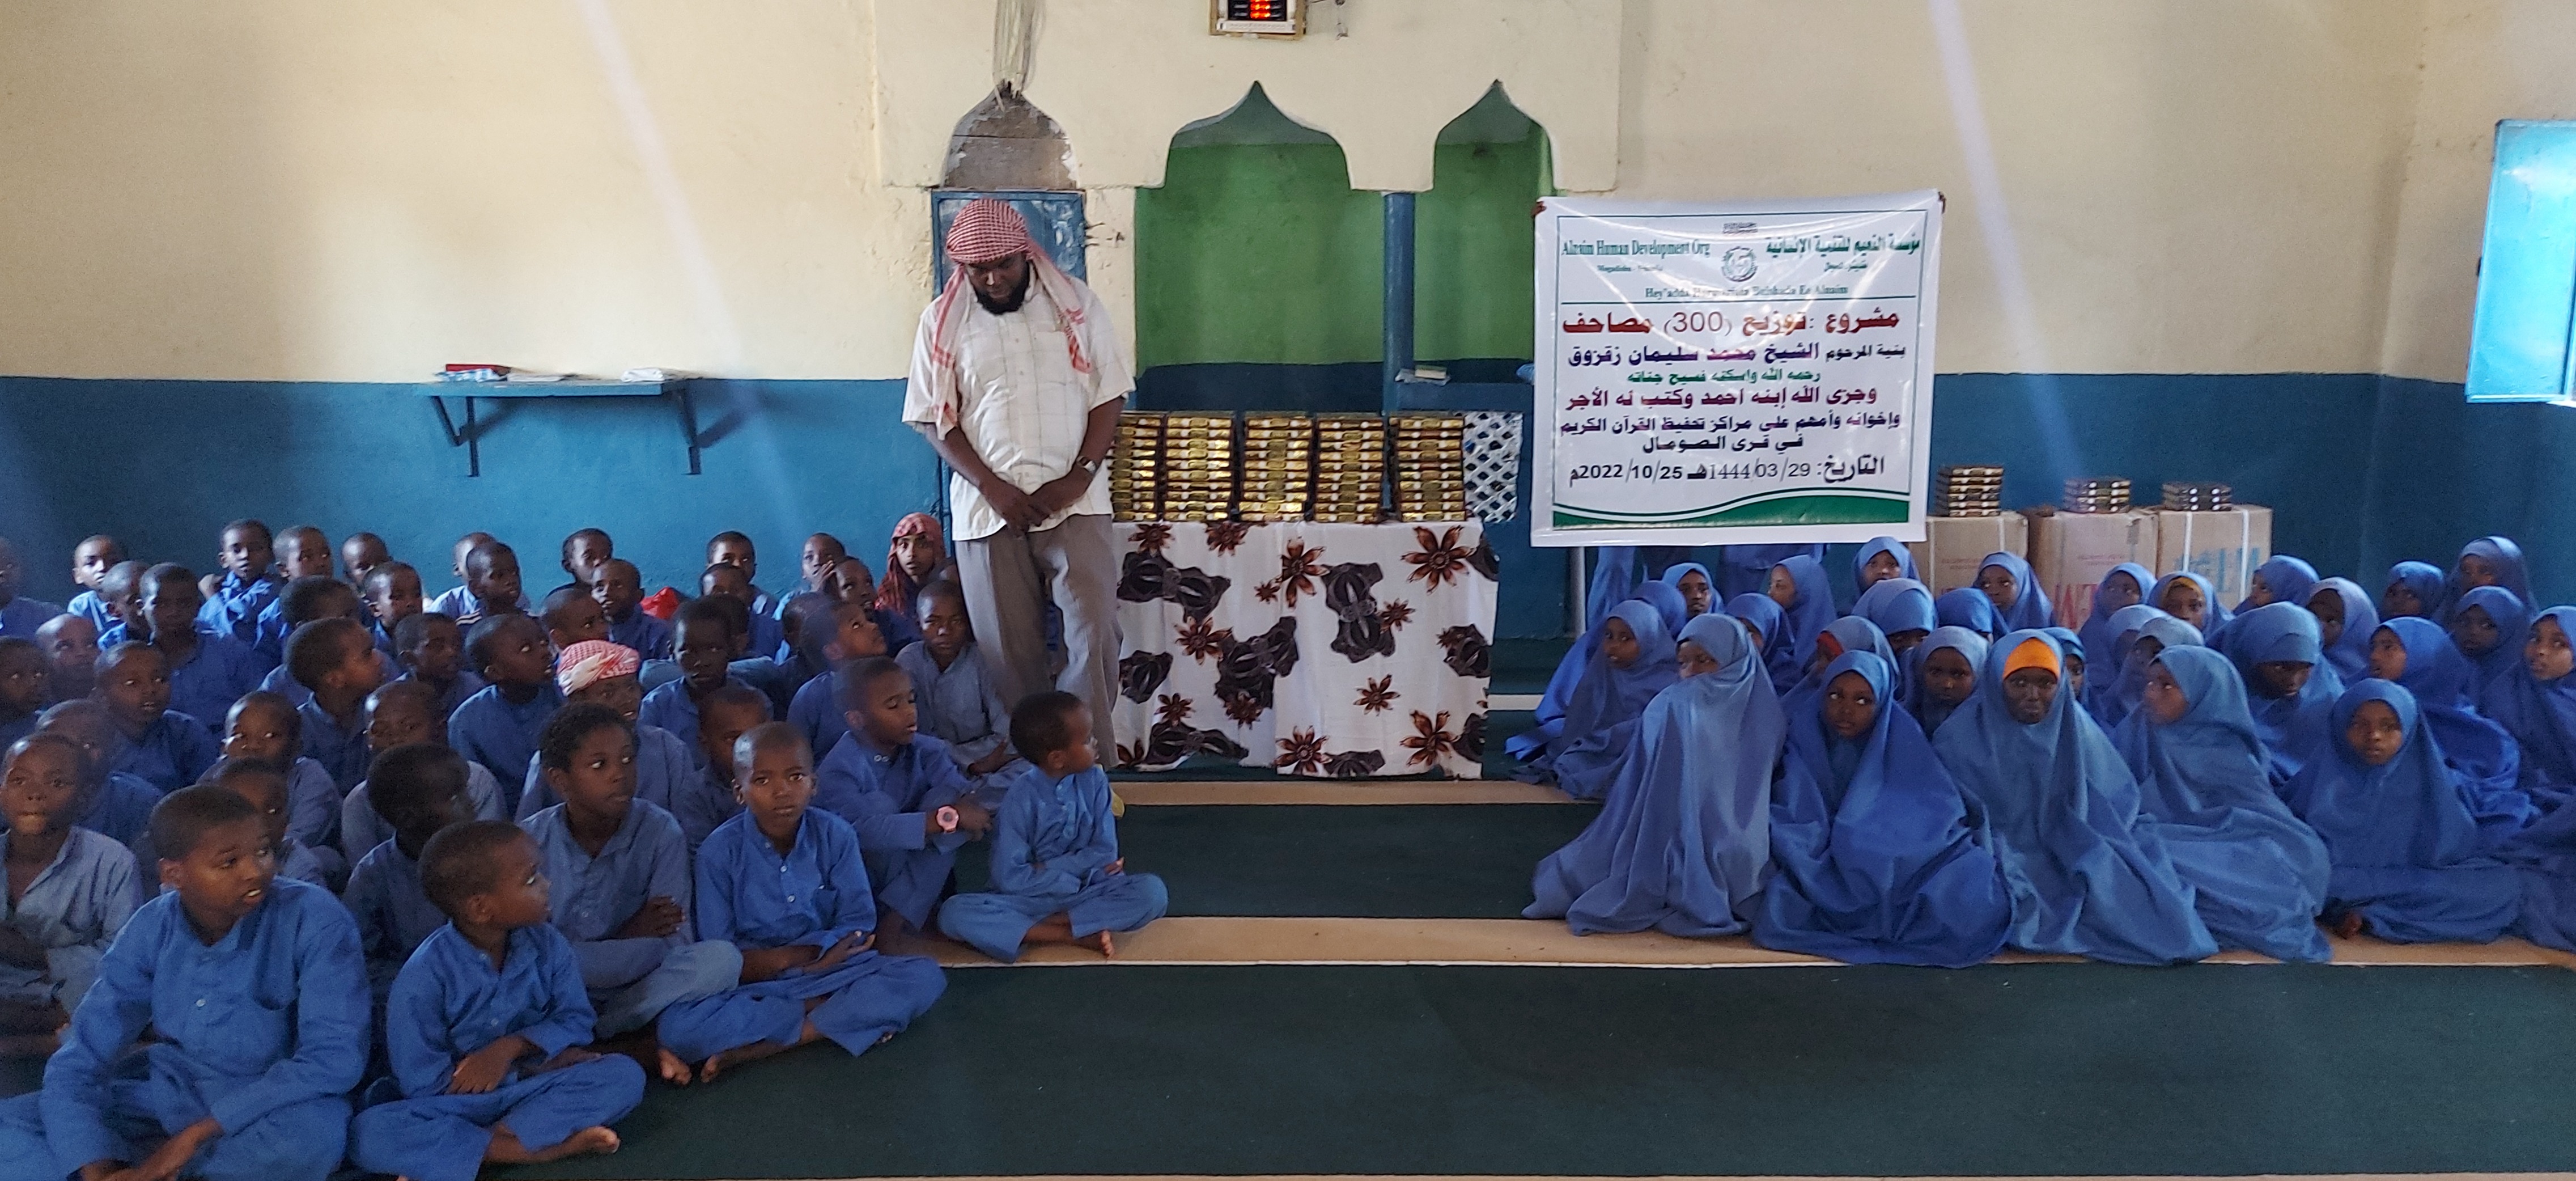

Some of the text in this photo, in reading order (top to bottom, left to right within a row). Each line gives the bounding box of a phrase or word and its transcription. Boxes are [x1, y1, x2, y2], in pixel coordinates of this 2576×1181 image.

[1691, 239, 1711, 257] Org
[1563, 312, 1653, 333] مصاحف
[1663, 311, 1733, 336] (300)
[1826, 307, 1899, 333] مشروع
[1628, 345, 1698, 366] سليمان
[1707, 348, 1756, 362] محمد
[1764, 341, 1819, 364] الشيخ
[1825, 344, 1873, 363] المرحوم
[1627, 368, 1663, 386] جناته
[1669, 370, 1706, 386] فسيح
[1760, 367, 1783, 380] الله
[1787, 370, 1821, 382] رحمه
[1564, 386, 1609, 411] الأجر
[1615, 390, 1633, 406] له
[1641, 388, 1694, 409] وكتب
[1790, 385, 1820, 403] الله
[1826, 387, 1878, 405] وجزى
[1560, 409, 1900, 438] وإخوانه وأمهم على مراكز تحفيظ القرآن الكريم
[1643, 433, 1804, 455] في قرى الصومال
[1817, 454, 1886, 484] التاريخ:
